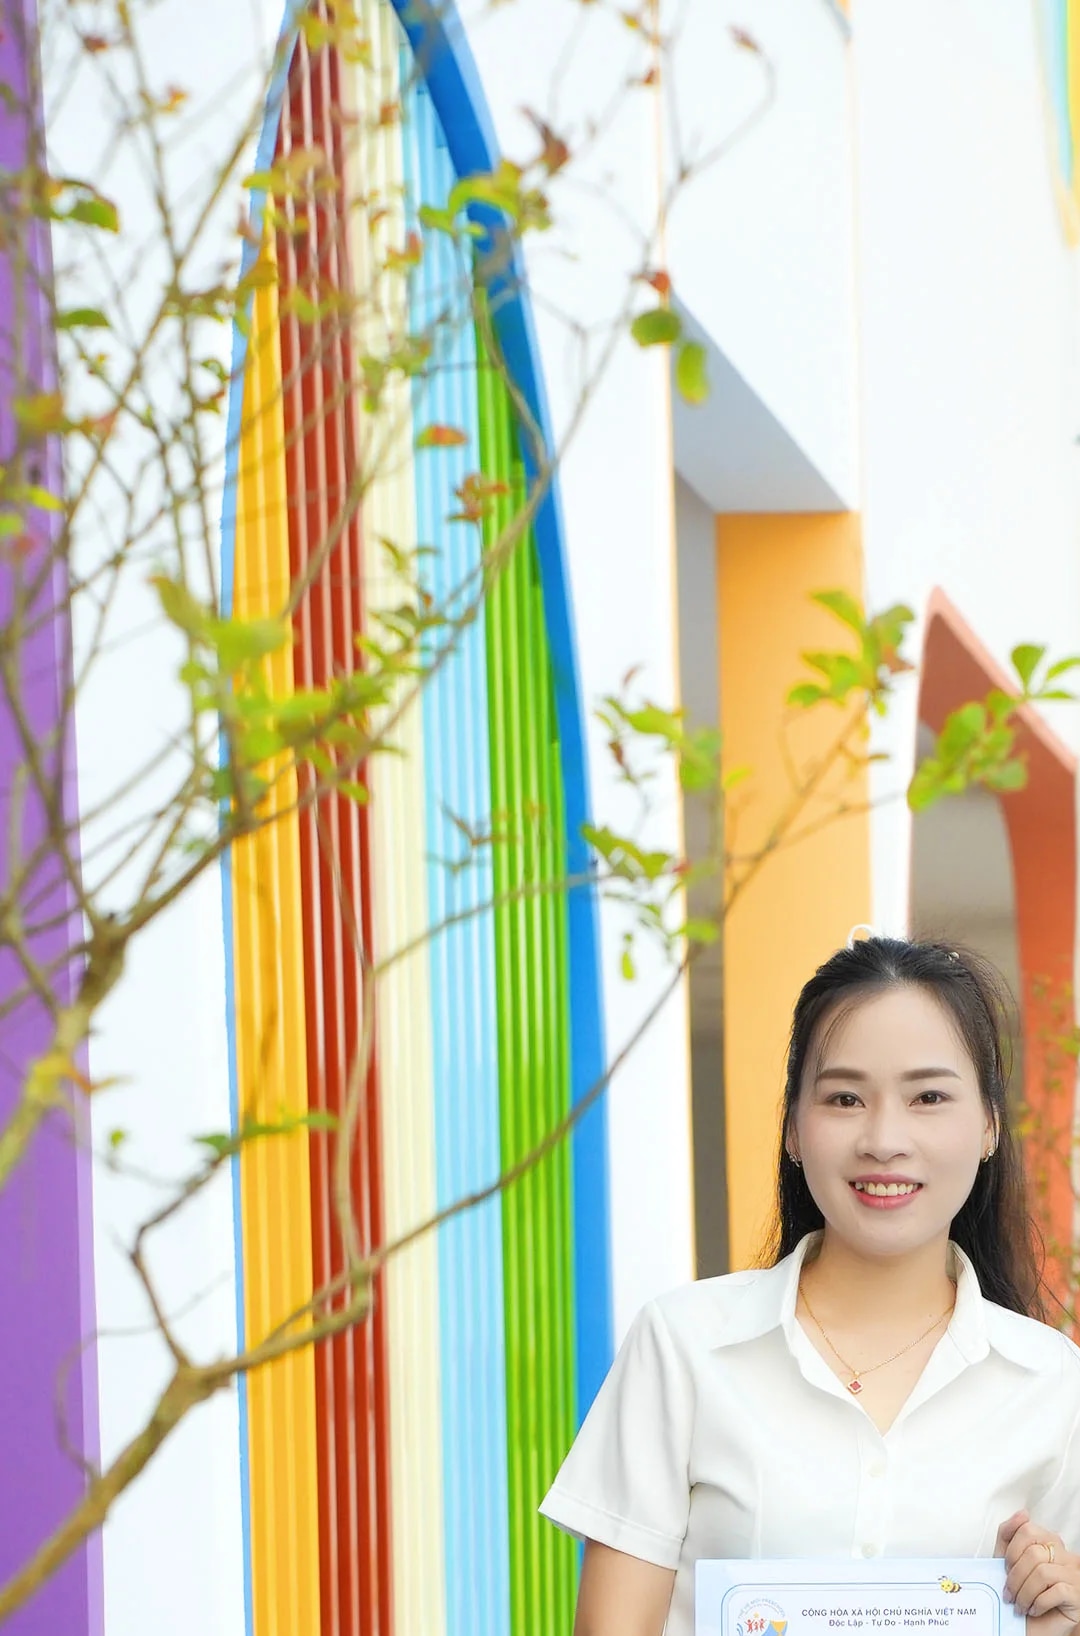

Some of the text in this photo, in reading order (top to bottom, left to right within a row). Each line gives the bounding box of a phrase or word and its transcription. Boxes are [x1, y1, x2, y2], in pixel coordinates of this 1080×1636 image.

[851, 1607, 863, 1616] XÃ
[865, 1607, 881, 1617] HỘI
[883, 1606, 902, 1616] CHỦ
[904, 1607, 932, 1616] NGHĨA
[935, 1606, 954, 1616] VIỆT
[829, 1619, 845, 1627] Độc
[848, 1619, 863, 1627] Lập
[903, 1619, 926, 1627] Hạnh
[928, 1618, 950, 1626] Phúc
